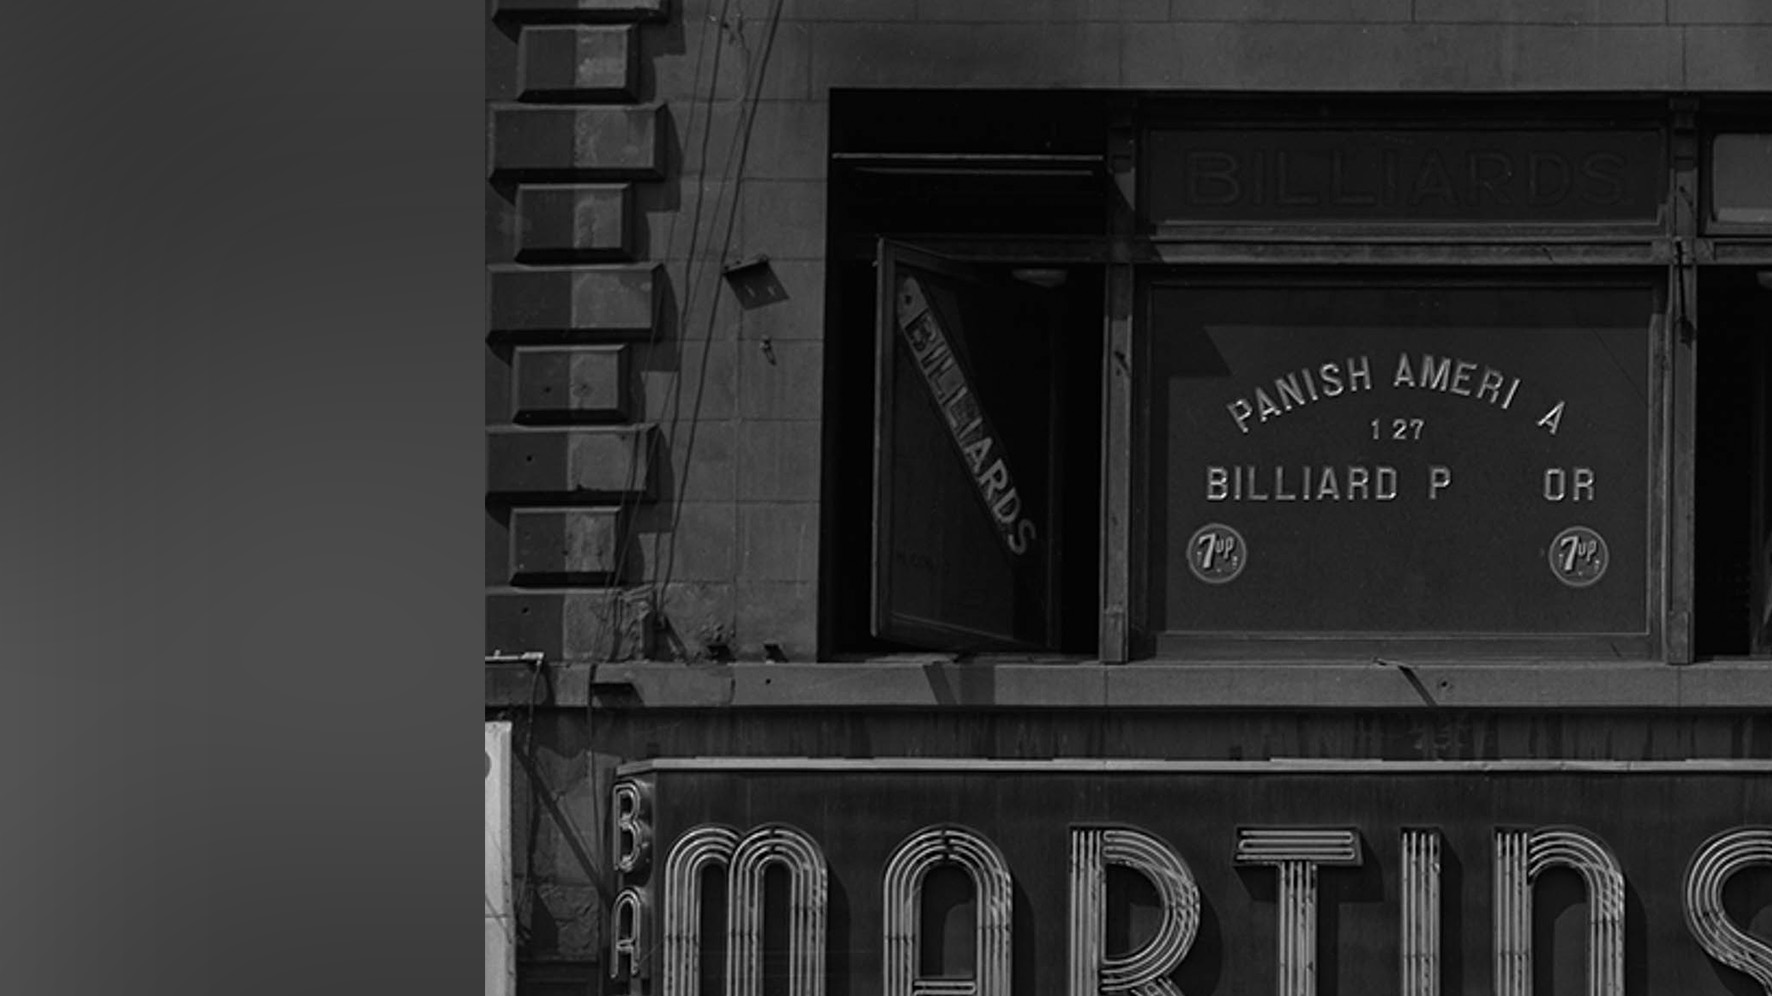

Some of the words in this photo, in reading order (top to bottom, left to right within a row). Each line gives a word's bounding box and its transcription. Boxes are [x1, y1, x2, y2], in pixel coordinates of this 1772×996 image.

[1185, 148, 1627, 206] BILLIARDS
[903, 308, 1037, 556] BILLIARDS
[1205, 464, 1400, 502] BILLIARD
